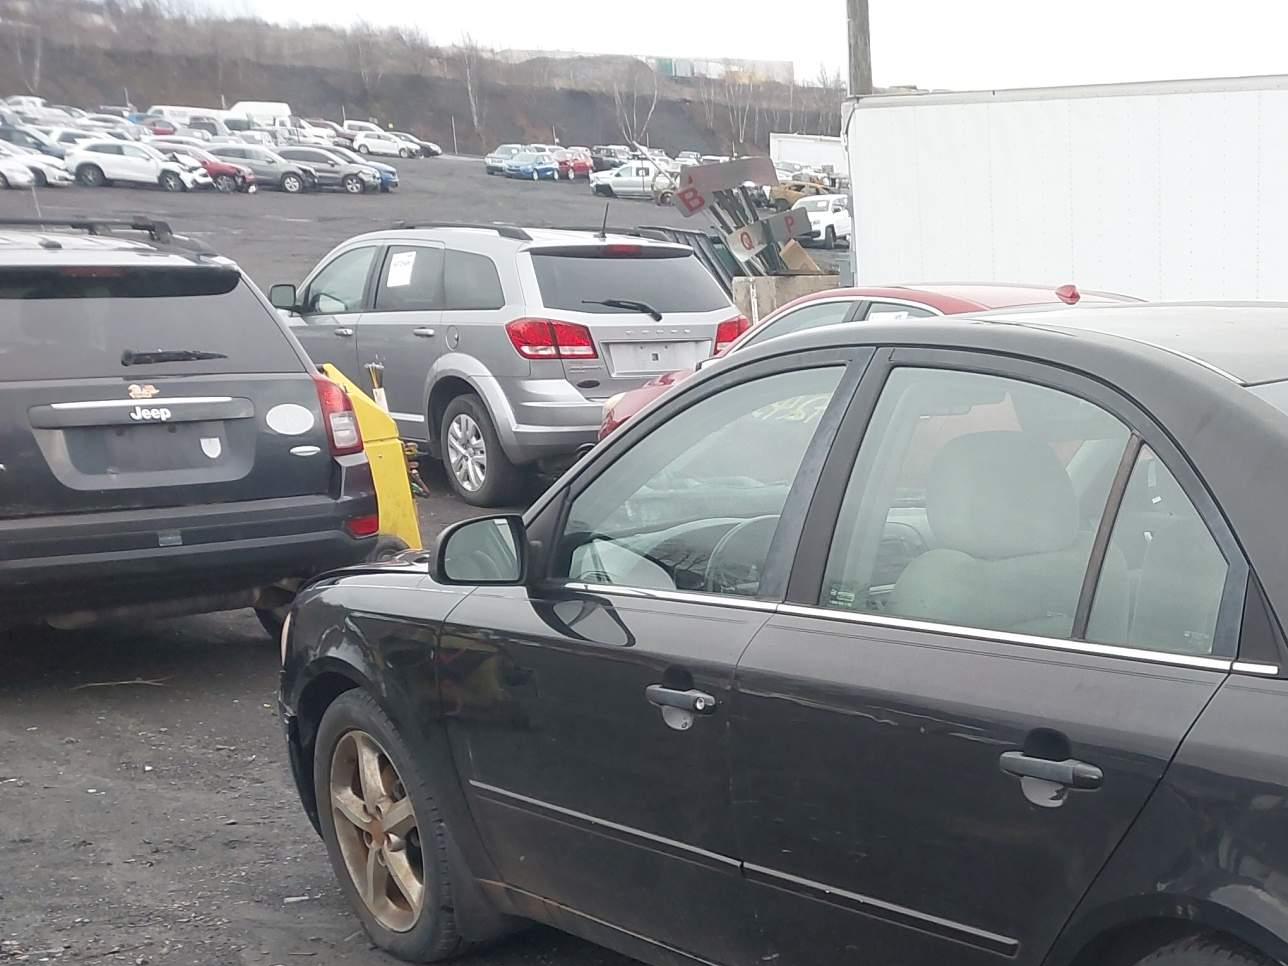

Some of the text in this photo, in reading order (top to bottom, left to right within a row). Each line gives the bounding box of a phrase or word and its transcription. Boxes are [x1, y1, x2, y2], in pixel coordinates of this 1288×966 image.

[678, 187, 705, 213] B
[784, 215, 795, 237] P
[740, 231, 755, 251] Q
[130, 406, 172, 421] Jeep
